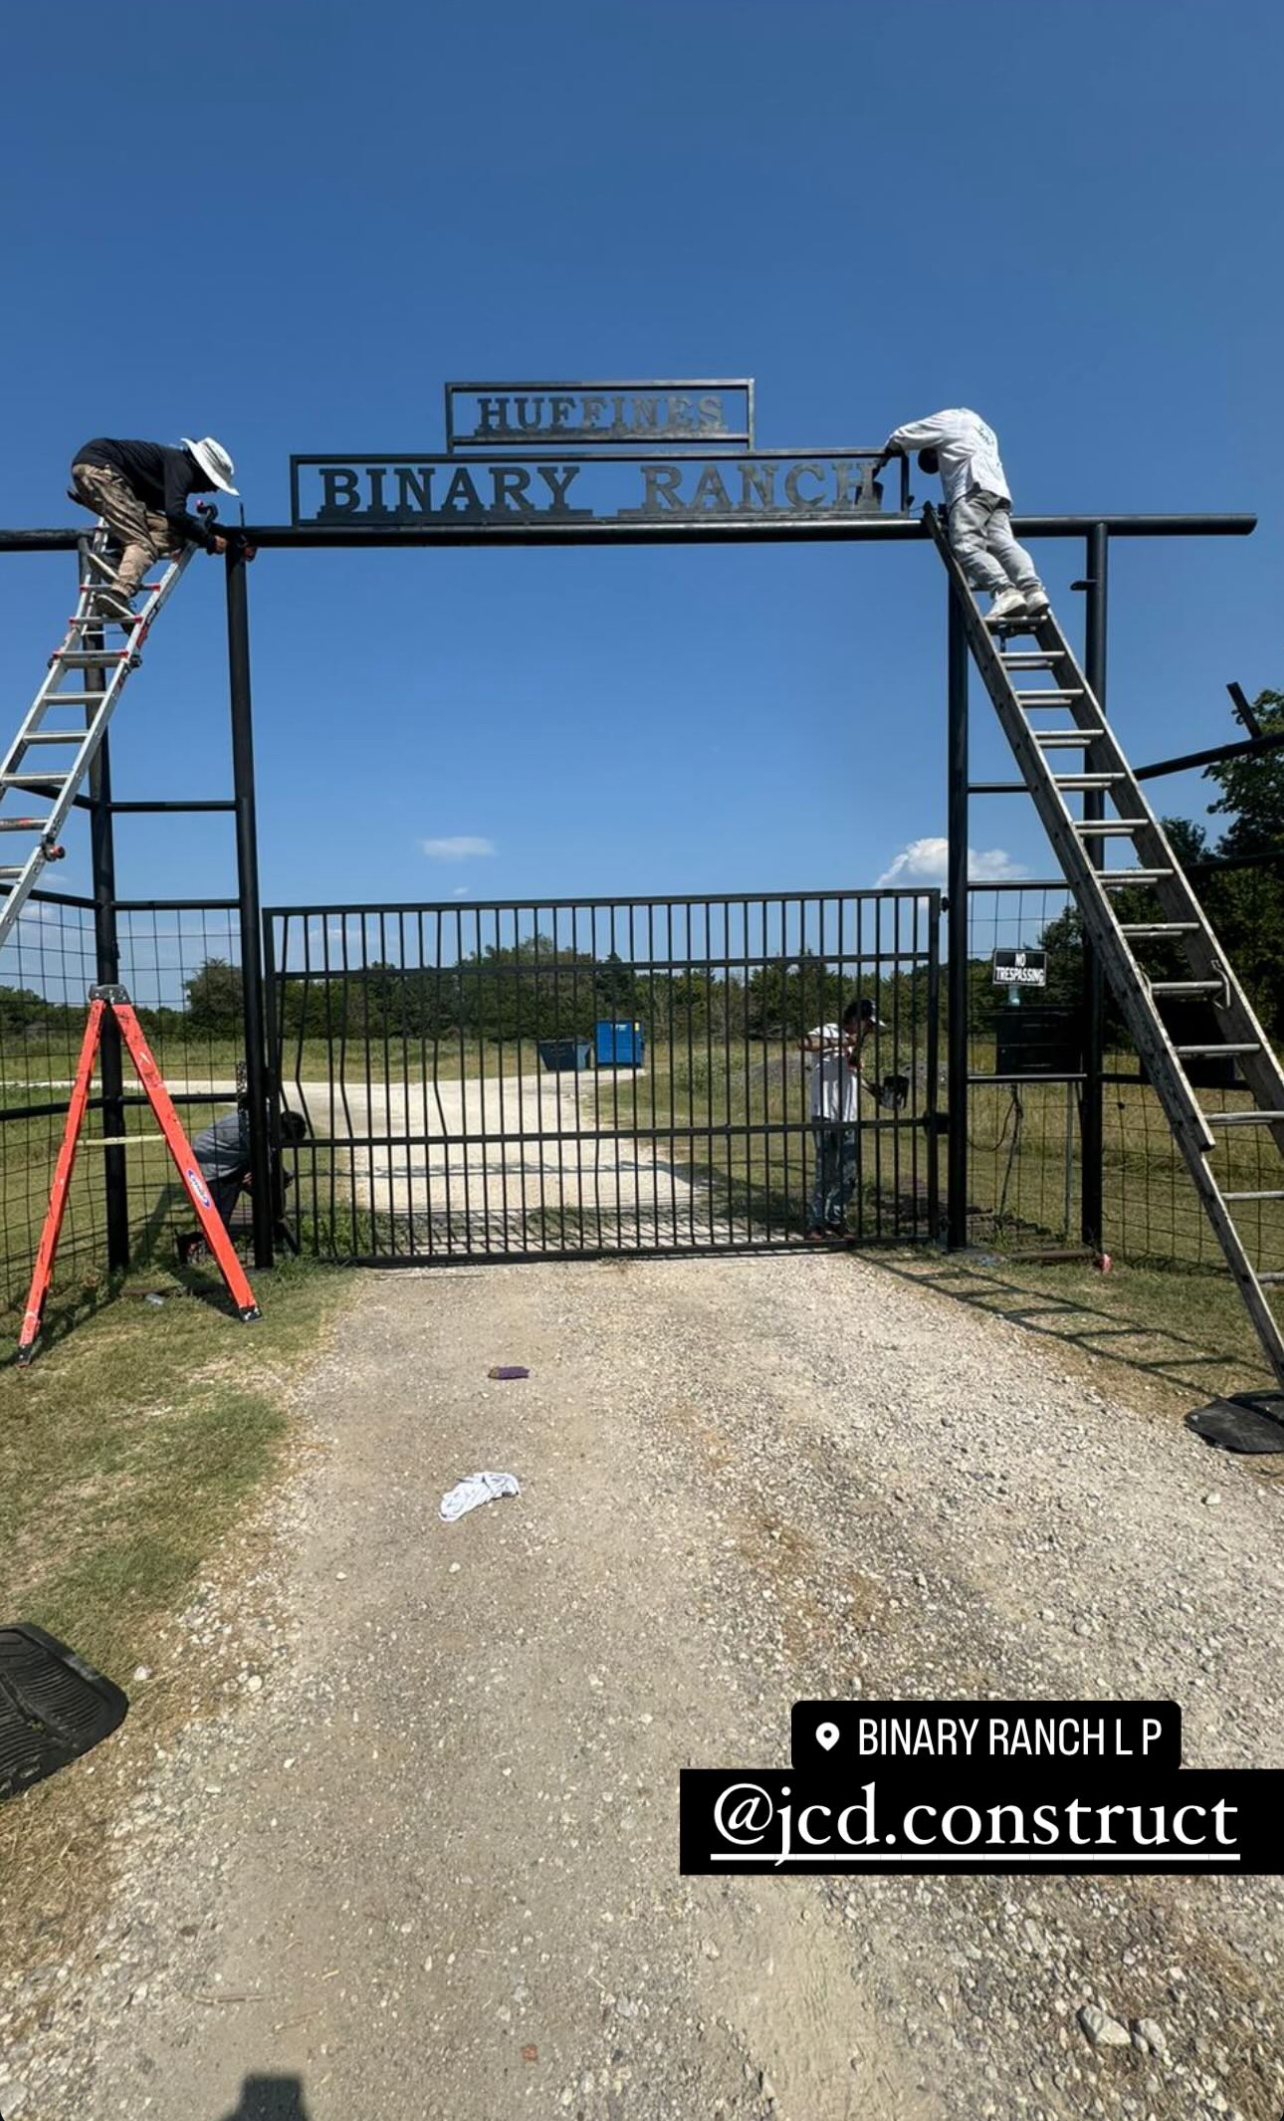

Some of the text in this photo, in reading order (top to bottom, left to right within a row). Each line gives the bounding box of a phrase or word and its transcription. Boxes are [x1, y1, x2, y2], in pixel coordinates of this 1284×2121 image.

[476, 395, 727, 434] HUFFINES
[318, 460, 881, 513] BINARY RANCH
[1014, 952, 1027, 967] NO
[995, 966, 1044, 982] TRESPASSING
